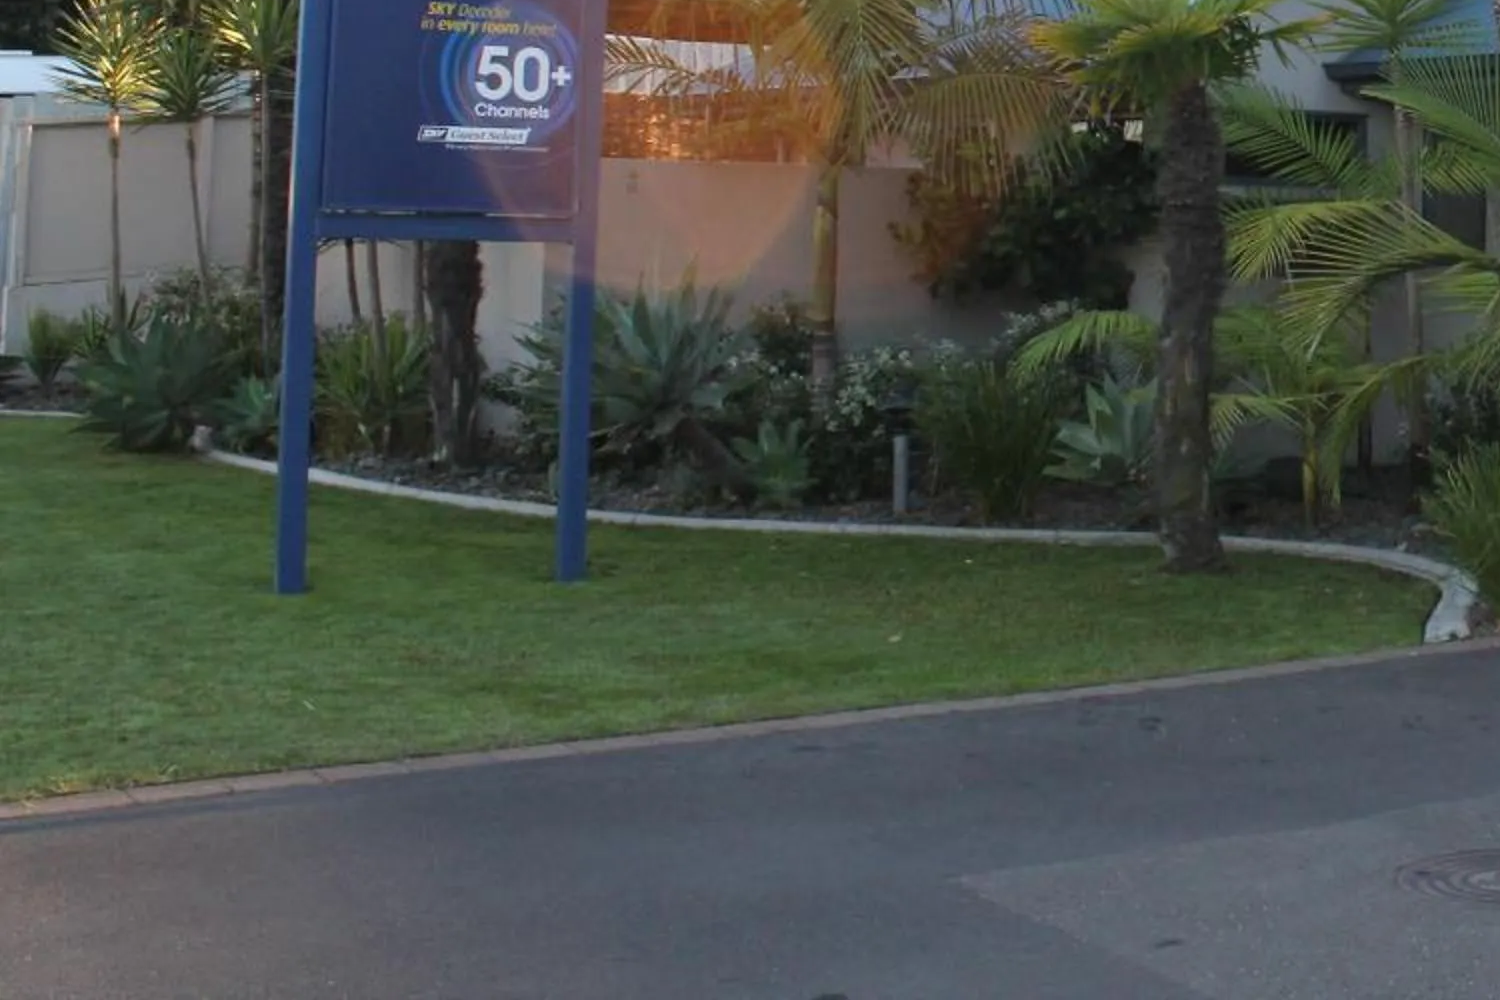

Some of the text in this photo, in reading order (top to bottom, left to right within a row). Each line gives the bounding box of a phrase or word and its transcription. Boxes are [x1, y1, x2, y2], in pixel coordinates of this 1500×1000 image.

[428, 2, 457, 15] SKY
[421, 16, 435, 30] in
[438, 19, 479, 34] every
[481, 21, 519, 34] room
[475, 45, 571, 103] 50+
[474, 102, 550, 120] Channels
